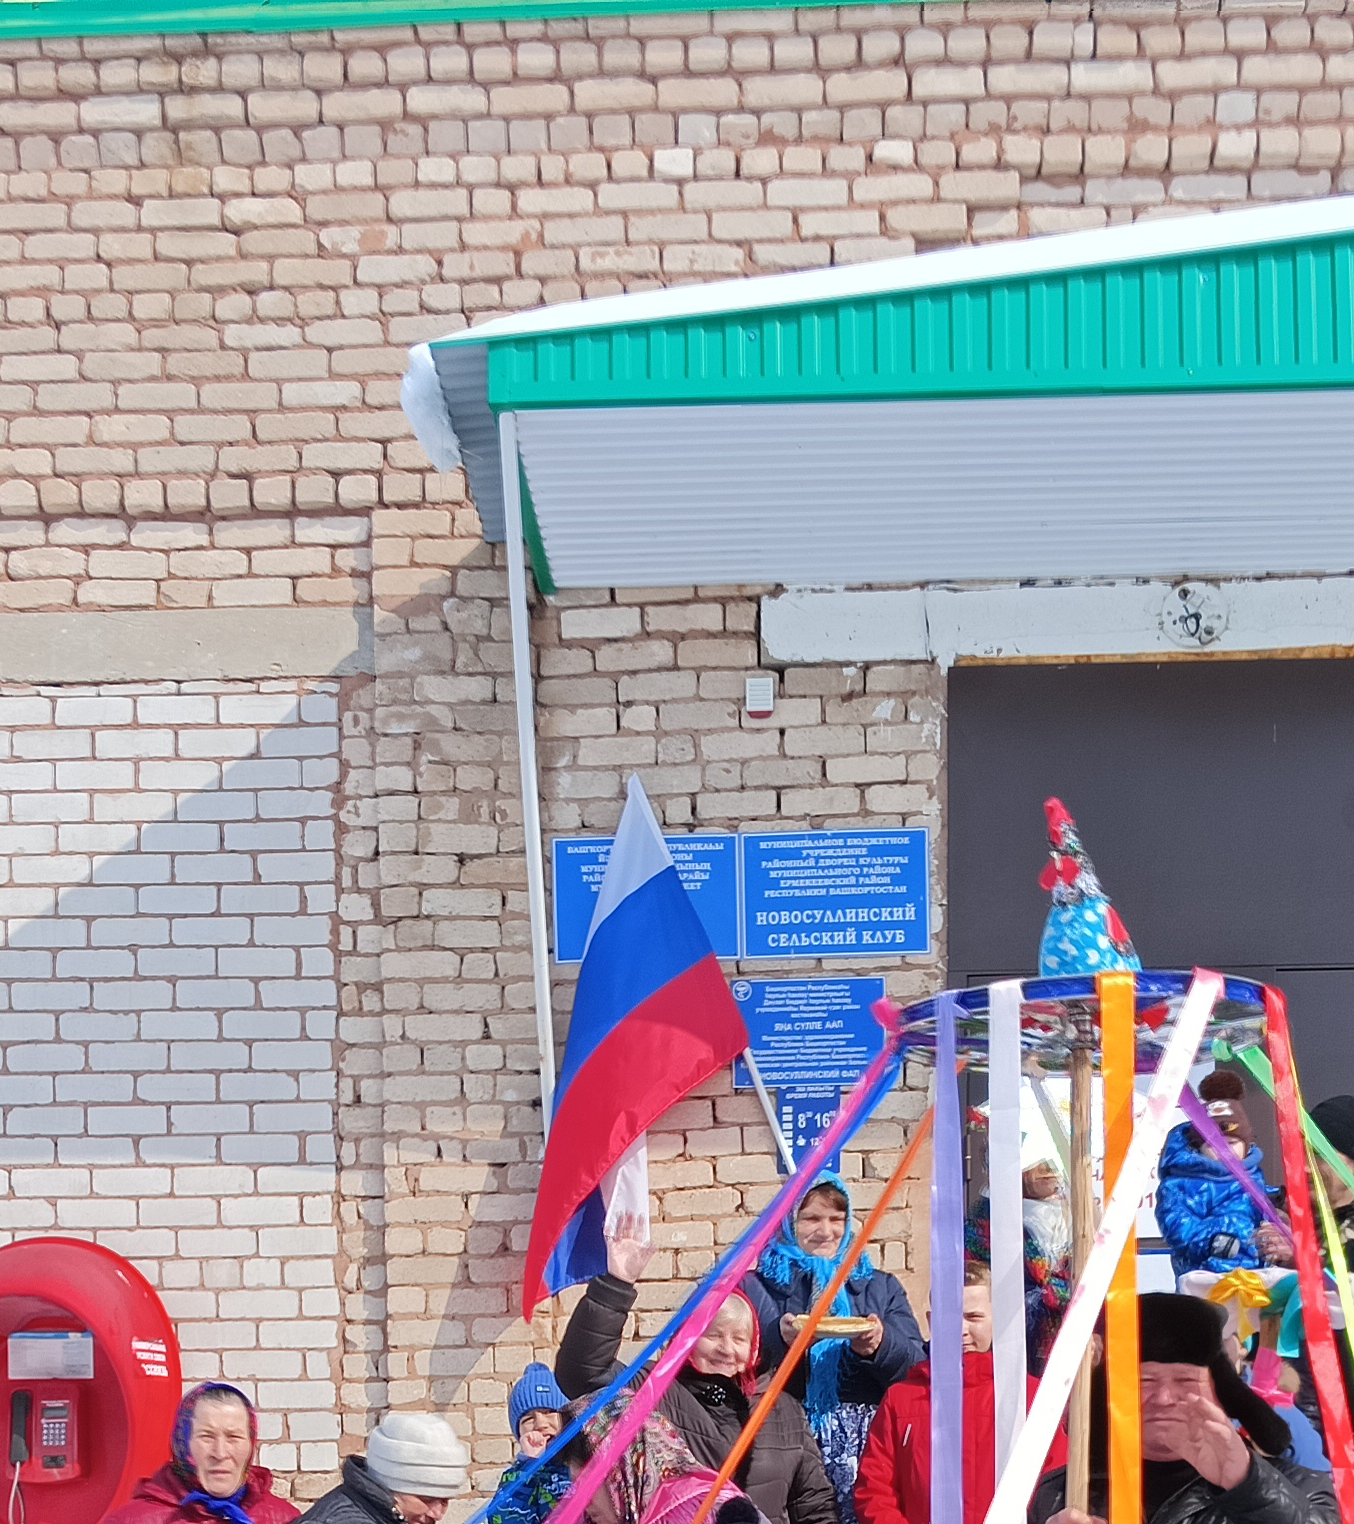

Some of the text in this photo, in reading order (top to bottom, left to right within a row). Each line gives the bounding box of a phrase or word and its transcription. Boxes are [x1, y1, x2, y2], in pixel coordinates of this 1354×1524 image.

[759, 837, 909, 849] МУНИЦИПАЛЬНОЕ БЮДЖЕТНОЕ
[761, 856, 908, 868] РАЙОННЫЙ ДВОРЕЦ КУЛЬТУРЫ
[770, 866, 901, 877] МУНИЦИПАЛЬНОГО РАЙОНА
[859, 876, 890, 884] РАЙОН
[764, 886, 907, 898] РЕСПУБЛИКИ БАШКОРТОСТАН
[756, 903, 917, 925] НОВОСУЛЛИНСКИЙ
[768, 928, 905, 947] СЕЛЬСКИЙ КЛУБ
